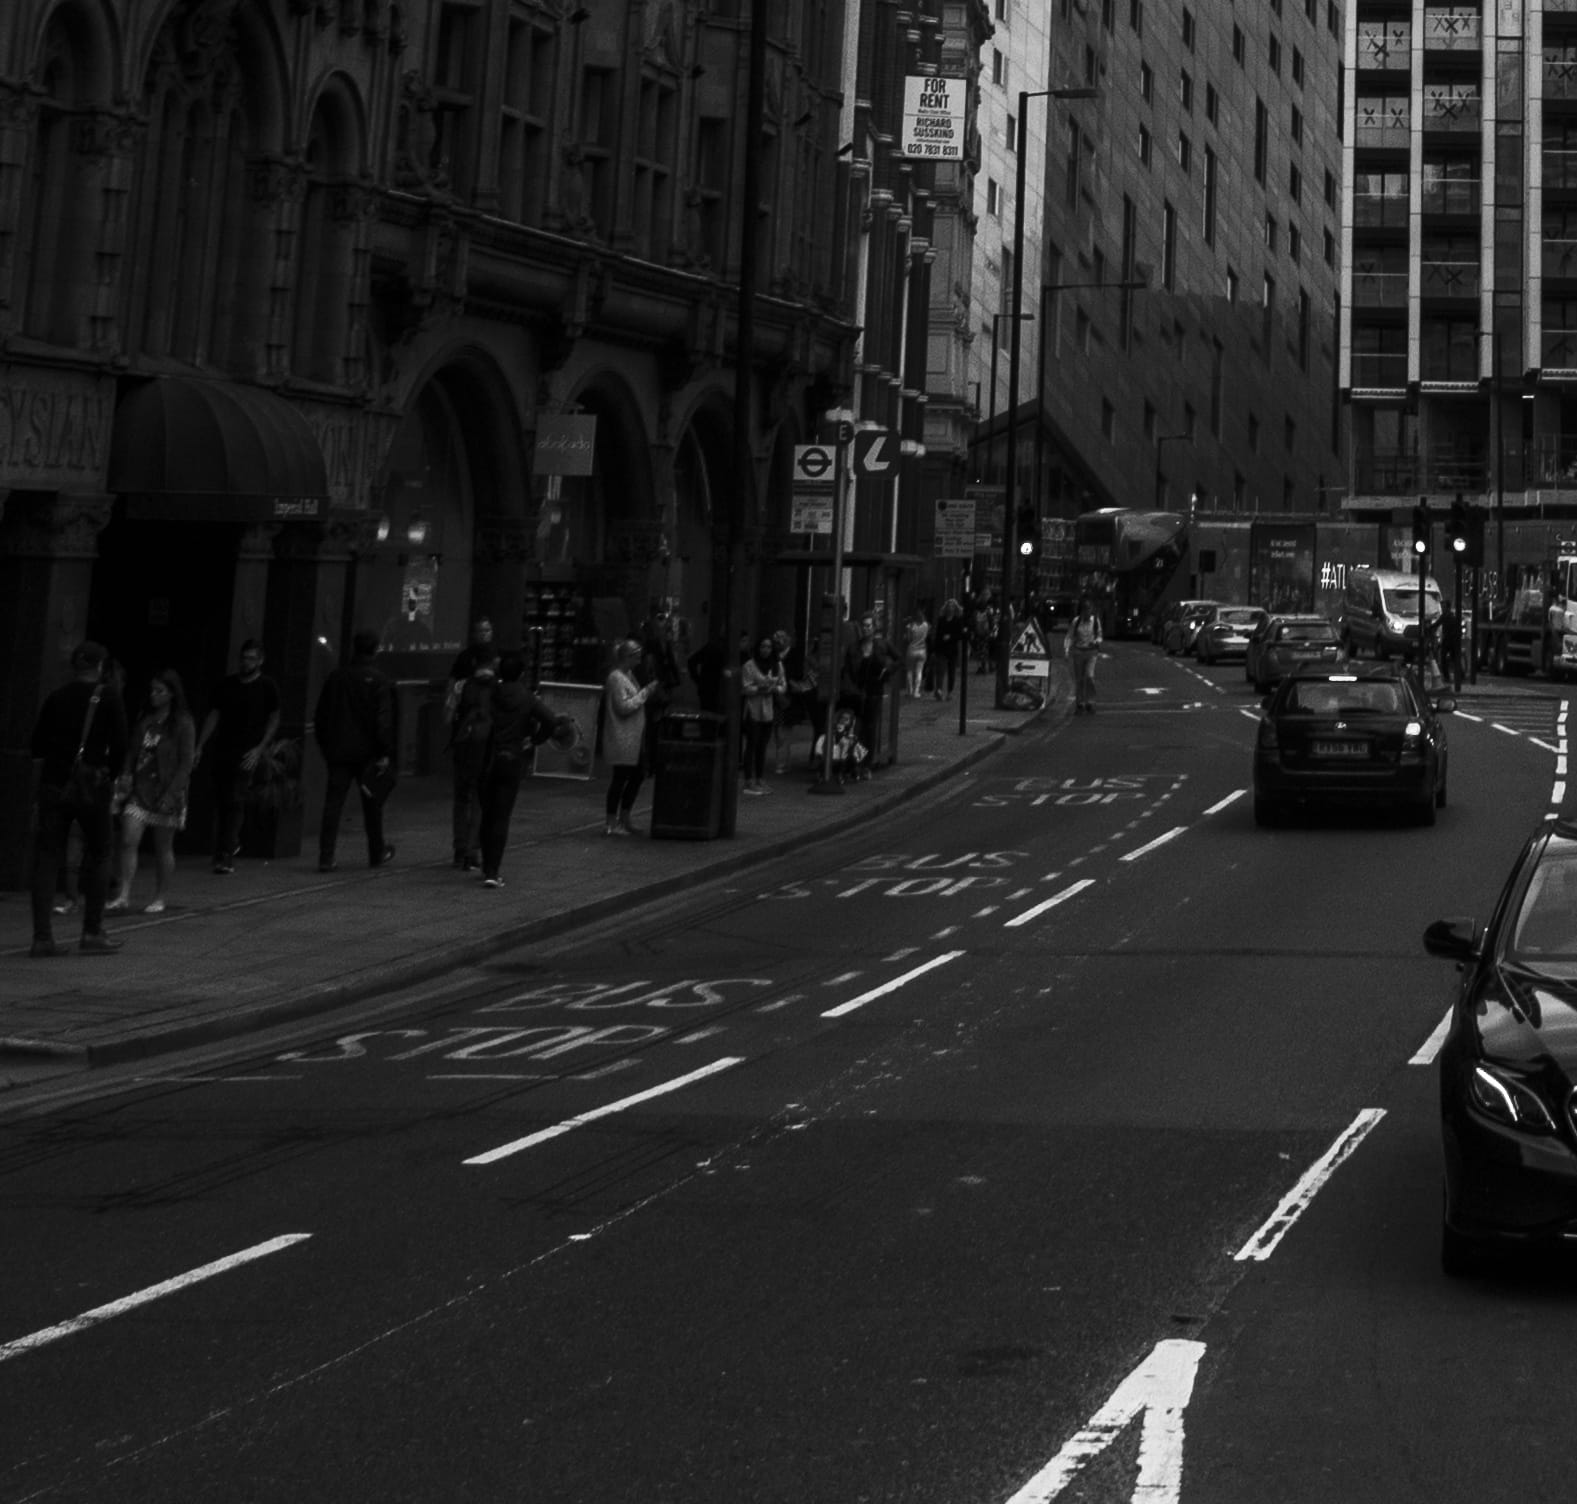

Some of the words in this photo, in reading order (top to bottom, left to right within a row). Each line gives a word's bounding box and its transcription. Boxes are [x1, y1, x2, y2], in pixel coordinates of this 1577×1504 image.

[924, 78, 946, 93] FOR
[919, 93, 950, 109] RENT
[916, 117, 952, 129] RICHARD
[913, 127, 954, 139] SUSSKIND
[907, 143, 922, 154] 020
[838, 423, 847, 441] E
[303, 498, 319, 516] Hall
[1320, 559, 1372, 591] #ATL
[1013, 776, 1146, 791] BUS
[972, 792, 1146, 807] STOP
[841, 849, 1032, 872] BUS
[757, 875, 1013, 900] STOP
[474, 977, 775, 1014] BUS
[274, 1024, 676, 1063] STOP
